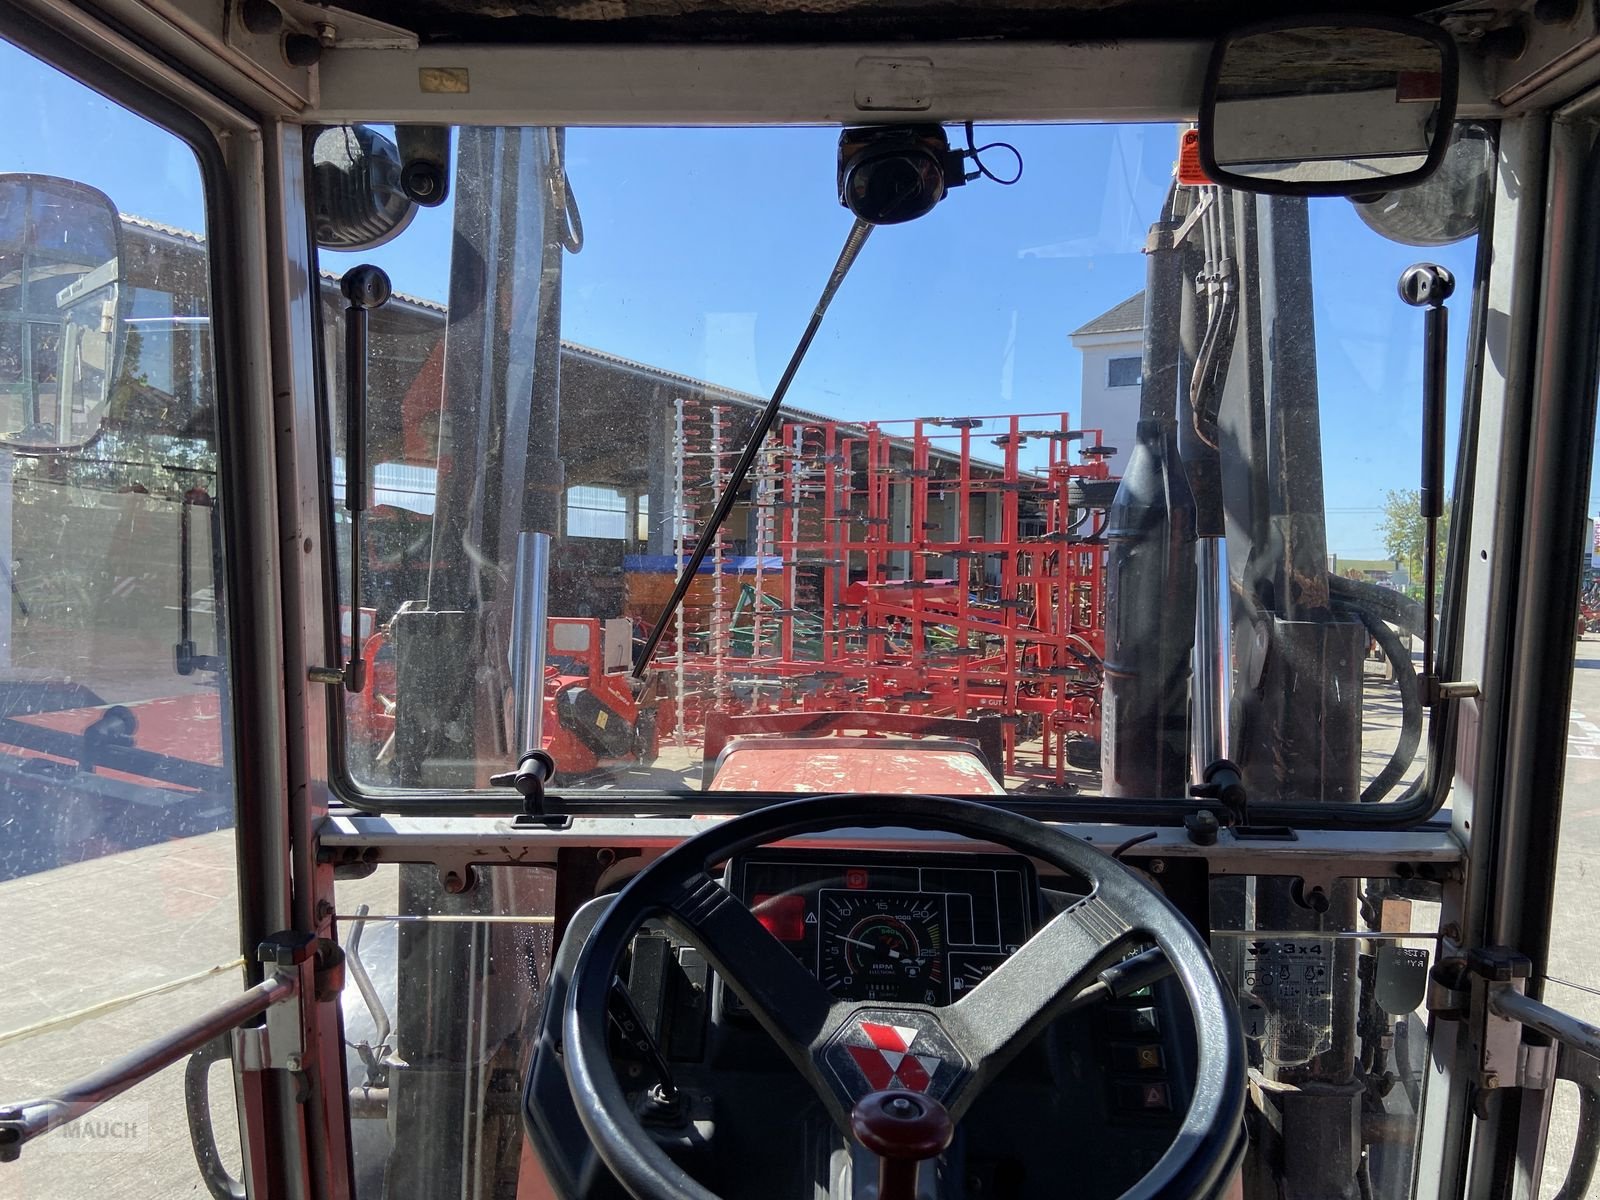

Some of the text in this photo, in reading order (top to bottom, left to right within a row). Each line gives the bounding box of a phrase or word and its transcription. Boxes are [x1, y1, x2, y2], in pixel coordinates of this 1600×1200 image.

[876, 902, 888, 910] 15
[839, 908, 851, 917] 10
[912, 910, 929, 918] 20
[831, 946, 840, 954] 5
[920, 948, 937, 957] 25
[843, 976, 853, 984] 0
